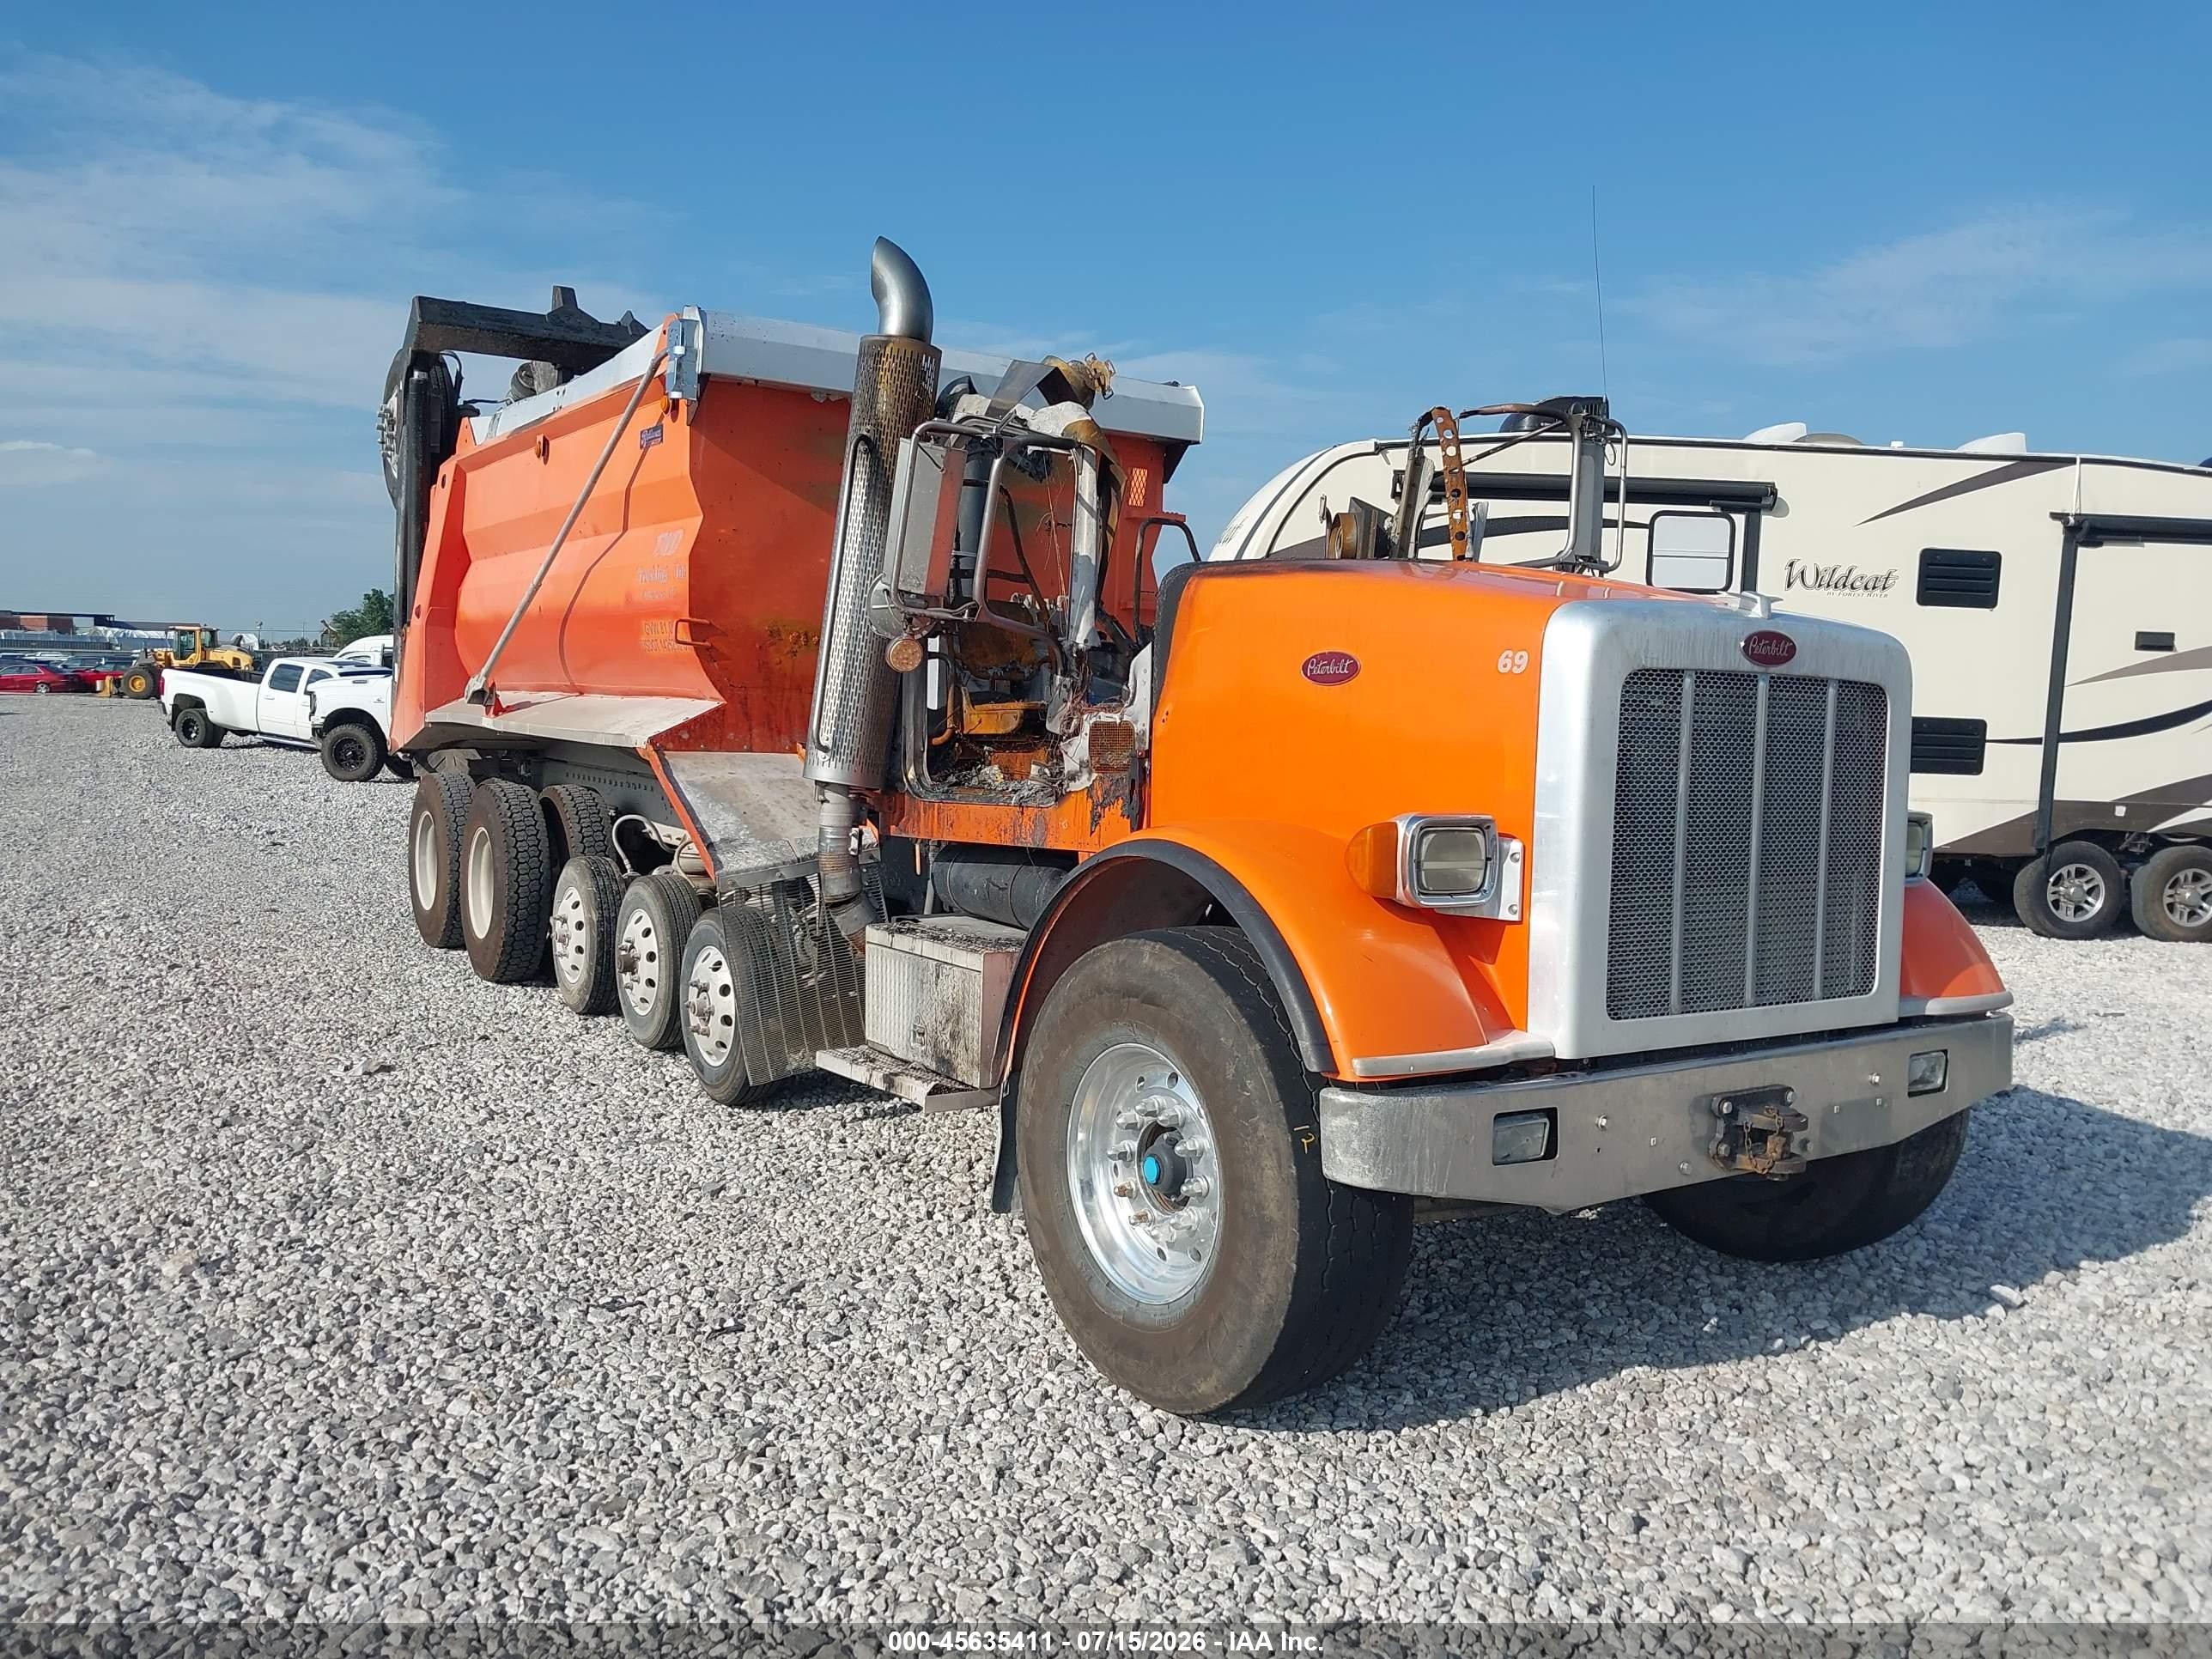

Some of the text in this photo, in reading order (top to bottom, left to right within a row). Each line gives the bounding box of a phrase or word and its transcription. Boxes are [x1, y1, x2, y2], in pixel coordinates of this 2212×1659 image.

[1784, 558, 1899, 592] Wildcat
[1748, 635, 1793, 657] Peterbilt
[1307, 658, 1354, 677] Peterbilt
[1497, 649, 1529, 674] 69
